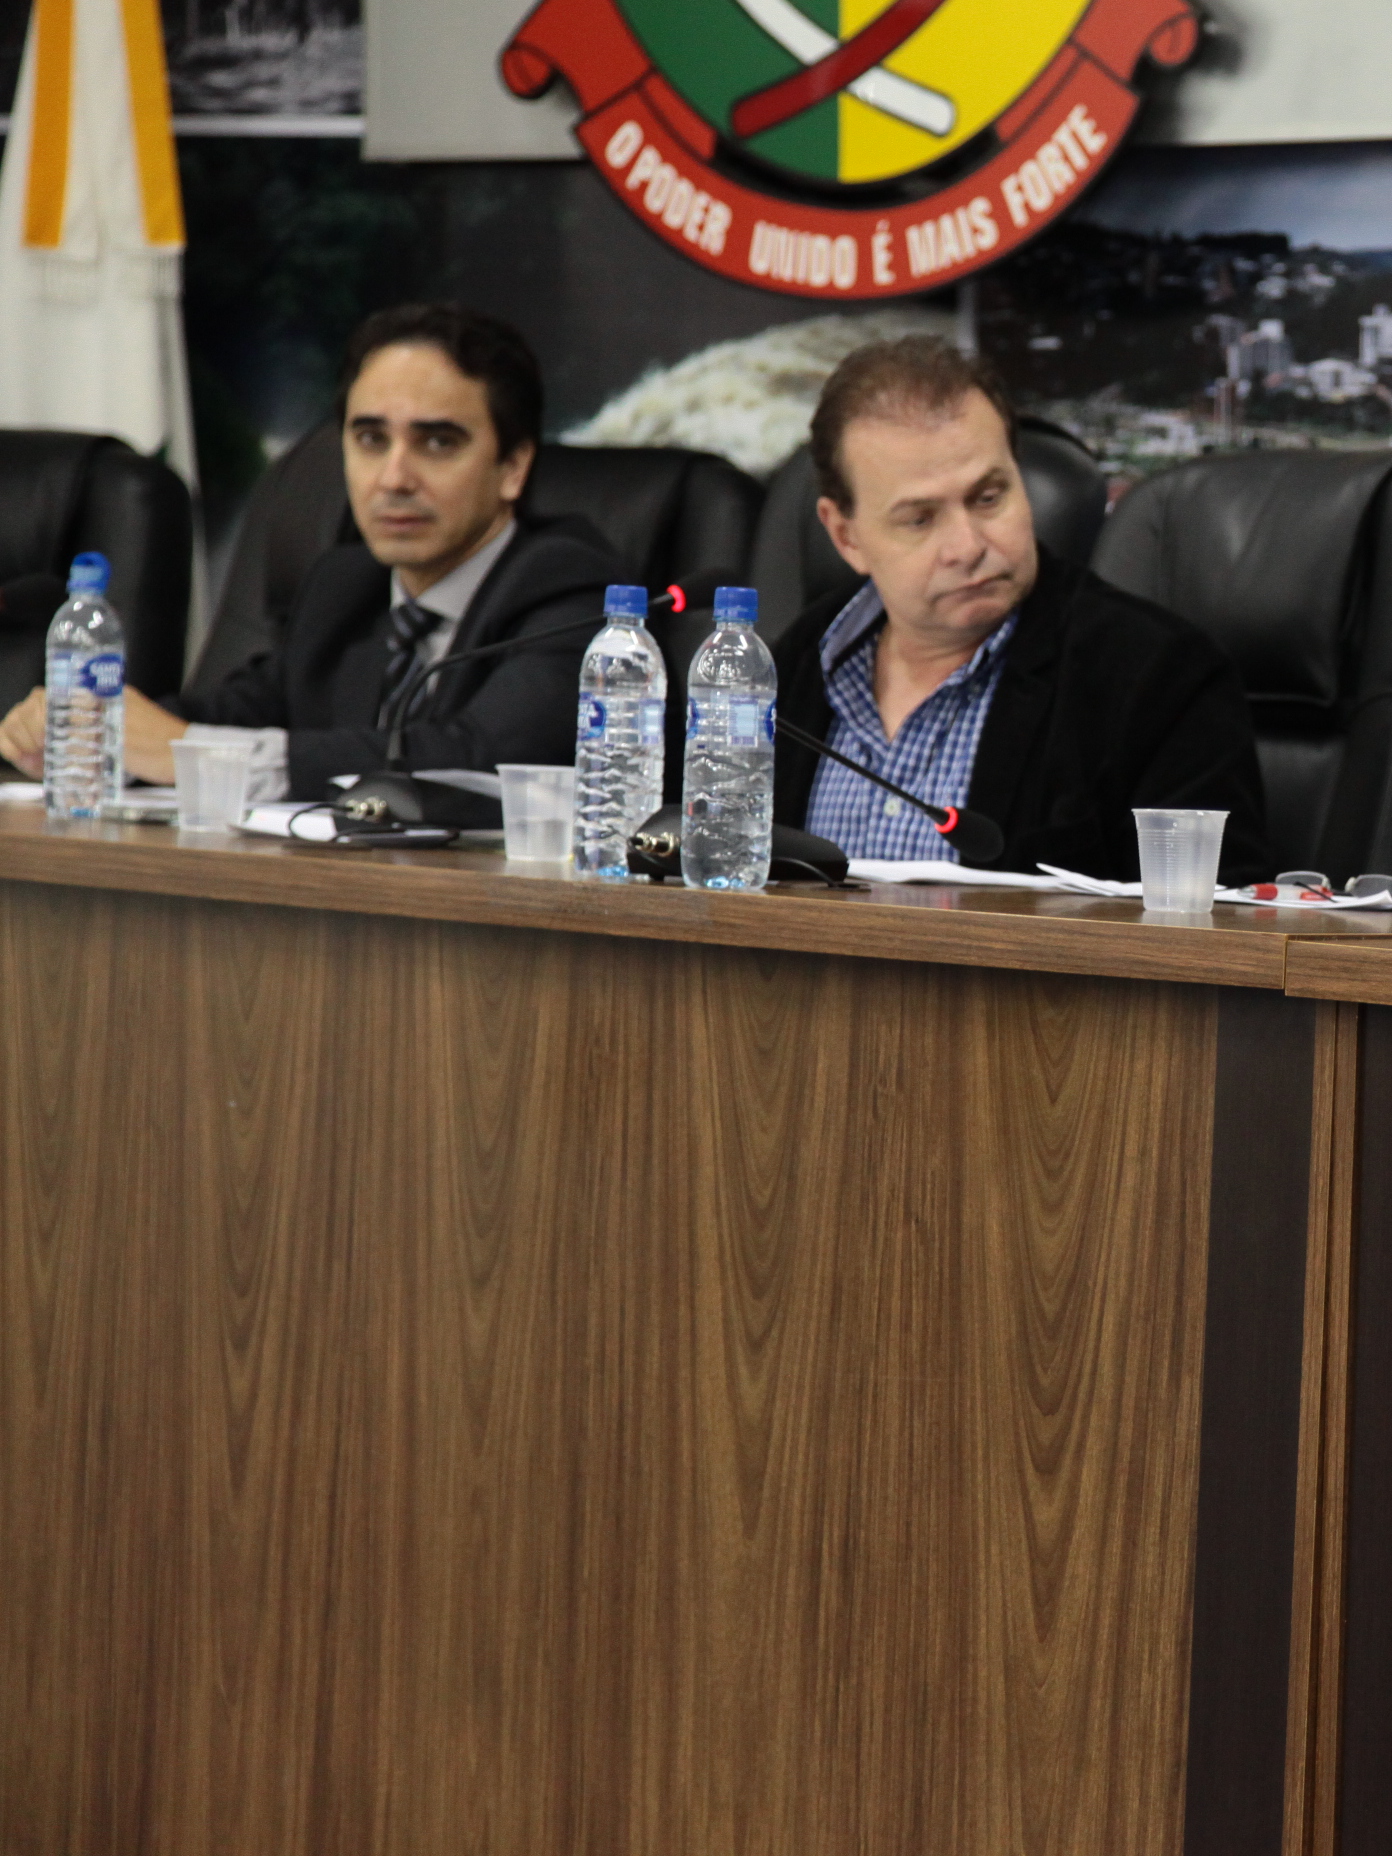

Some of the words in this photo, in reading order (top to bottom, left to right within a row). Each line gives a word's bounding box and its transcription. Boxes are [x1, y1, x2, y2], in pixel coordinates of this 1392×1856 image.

[605, 120, 643, 168] O
[626, 144, 732, 255] PODER
[748, 220, 858, 289] UNIDO
[872, 219, 895, 286] É
[905, 197, 999, 278] MAIS
[1000, 104, 1107, 228] FORTE
